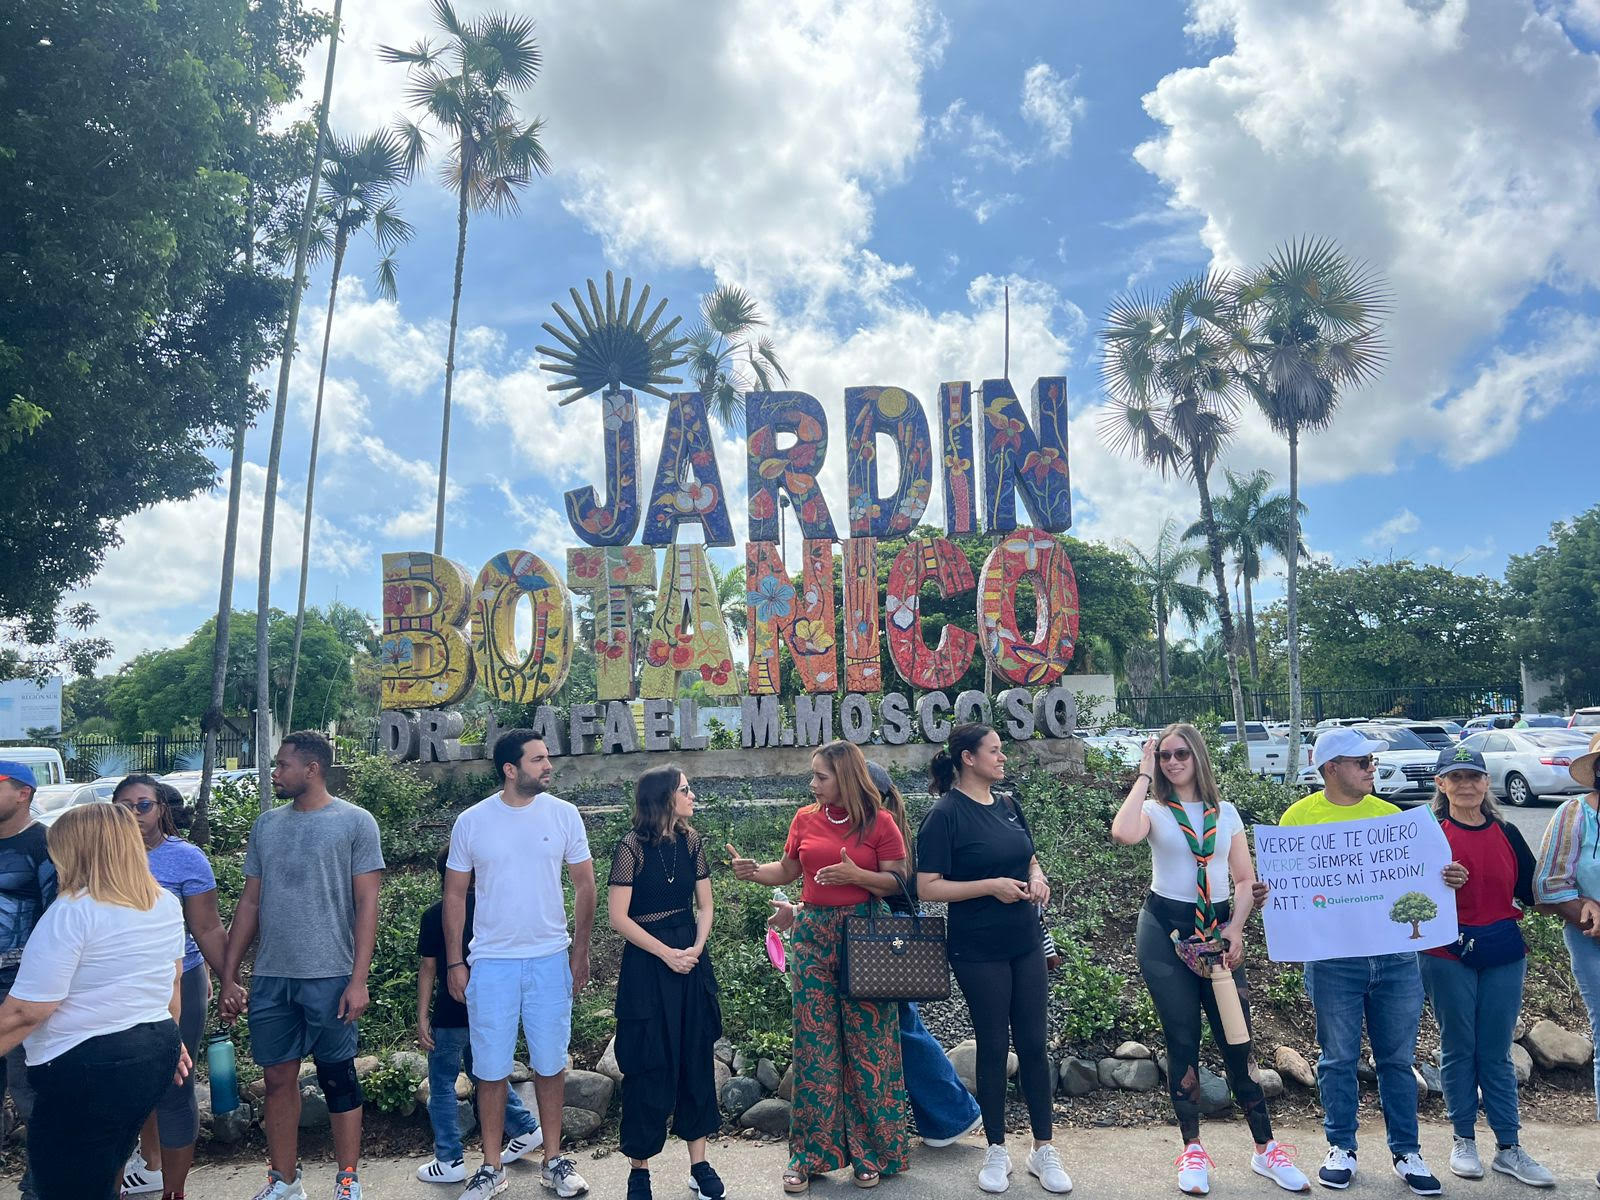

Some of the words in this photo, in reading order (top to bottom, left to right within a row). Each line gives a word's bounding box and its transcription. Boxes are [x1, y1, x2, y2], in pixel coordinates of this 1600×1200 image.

[564, 376, 1071, 547] JARDIN
[381, 529, 1079, 709] BOTANICO
[487, 699, 709, 756] AFAEL
[1259, 836, 1305, 853] VERDE
[1311, 833, 1336, 850] QUE
[1344, 831, 1362, 847] TE
[1367, 822, 1418, 845] QUIERO
[1262, 857, 1305, 872] VERDE
[1308, 853, 1364, 869] SIEMPRE
[1370, 846, 1410, 863] VERDE
[1291, 869, 1342, 889] TOQUES
[1347, 869, 1364, 885] MI
